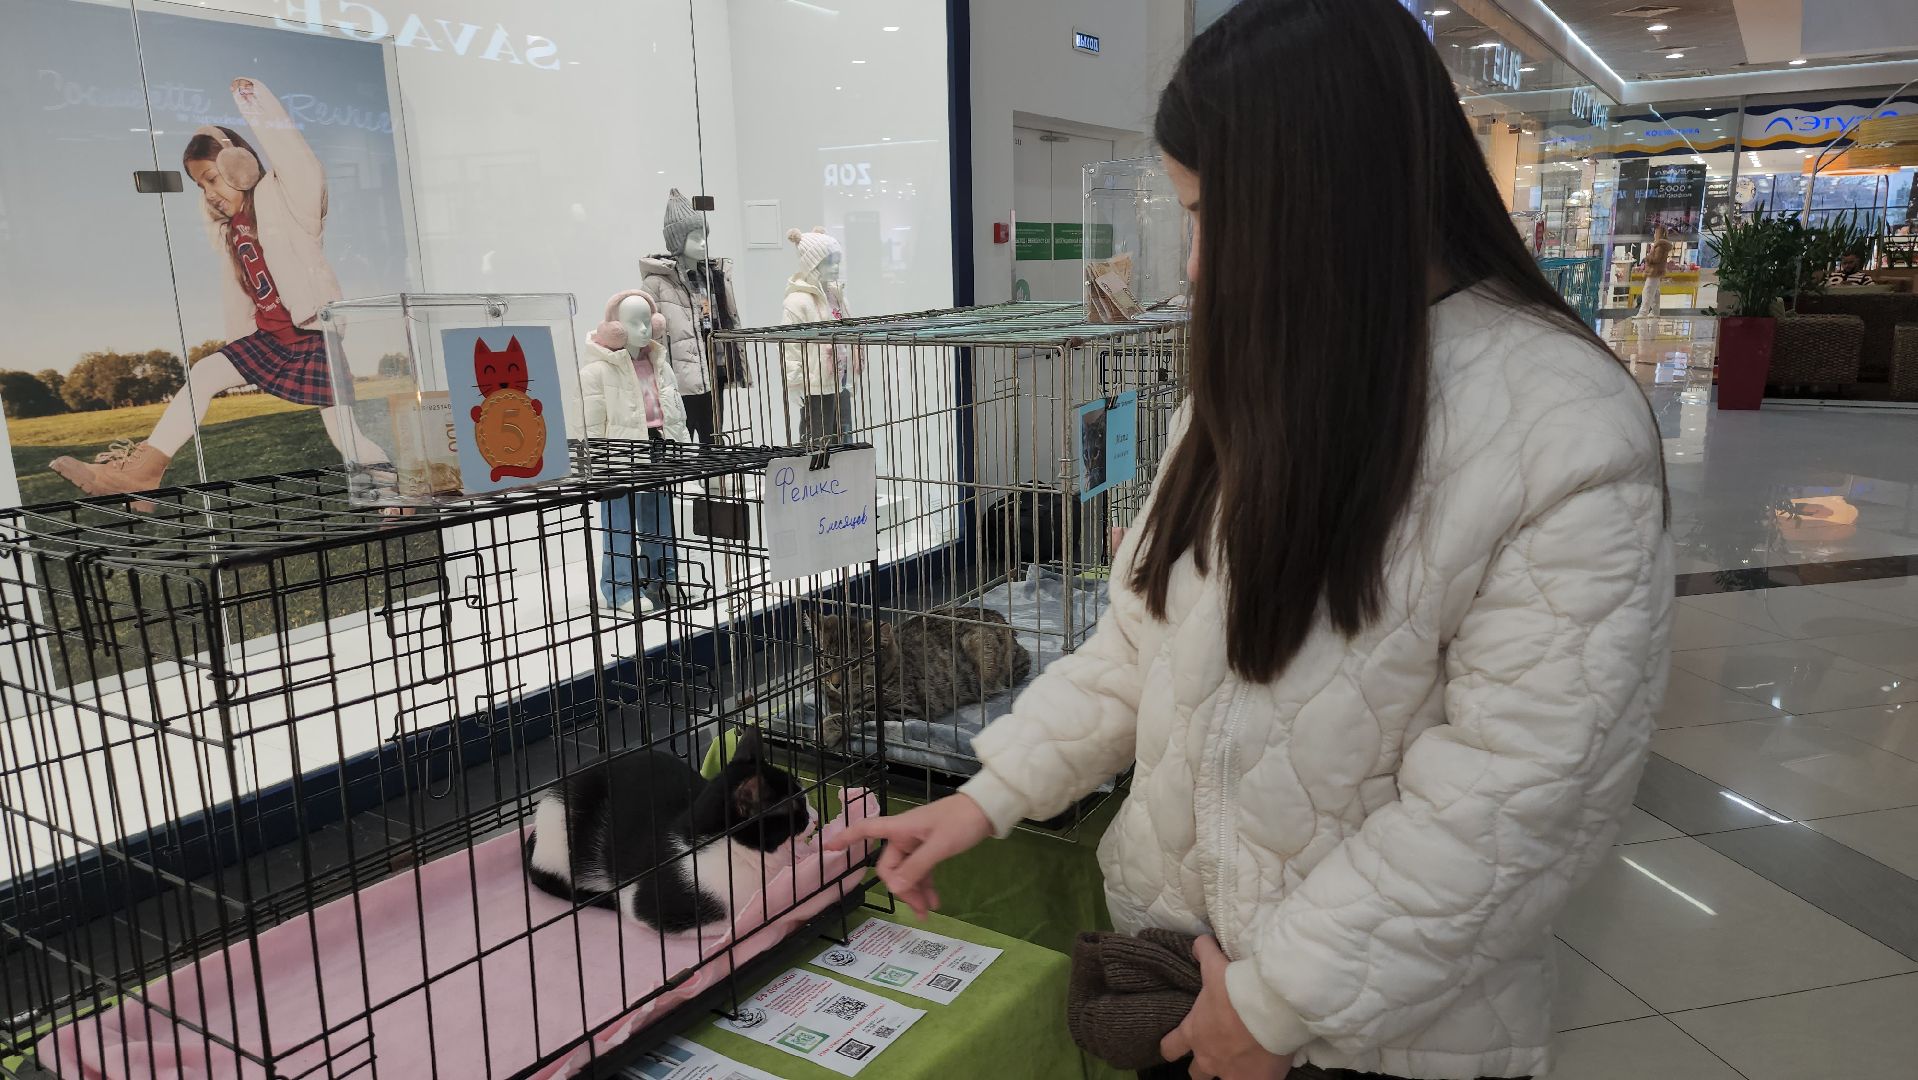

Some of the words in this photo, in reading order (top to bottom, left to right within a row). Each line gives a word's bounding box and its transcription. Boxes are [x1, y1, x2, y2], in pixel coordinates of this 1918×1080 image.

[503, 407, 526, 453] 5
[775, 466, 848, 505] Феликс
[818, 516, 827, 535] 5
